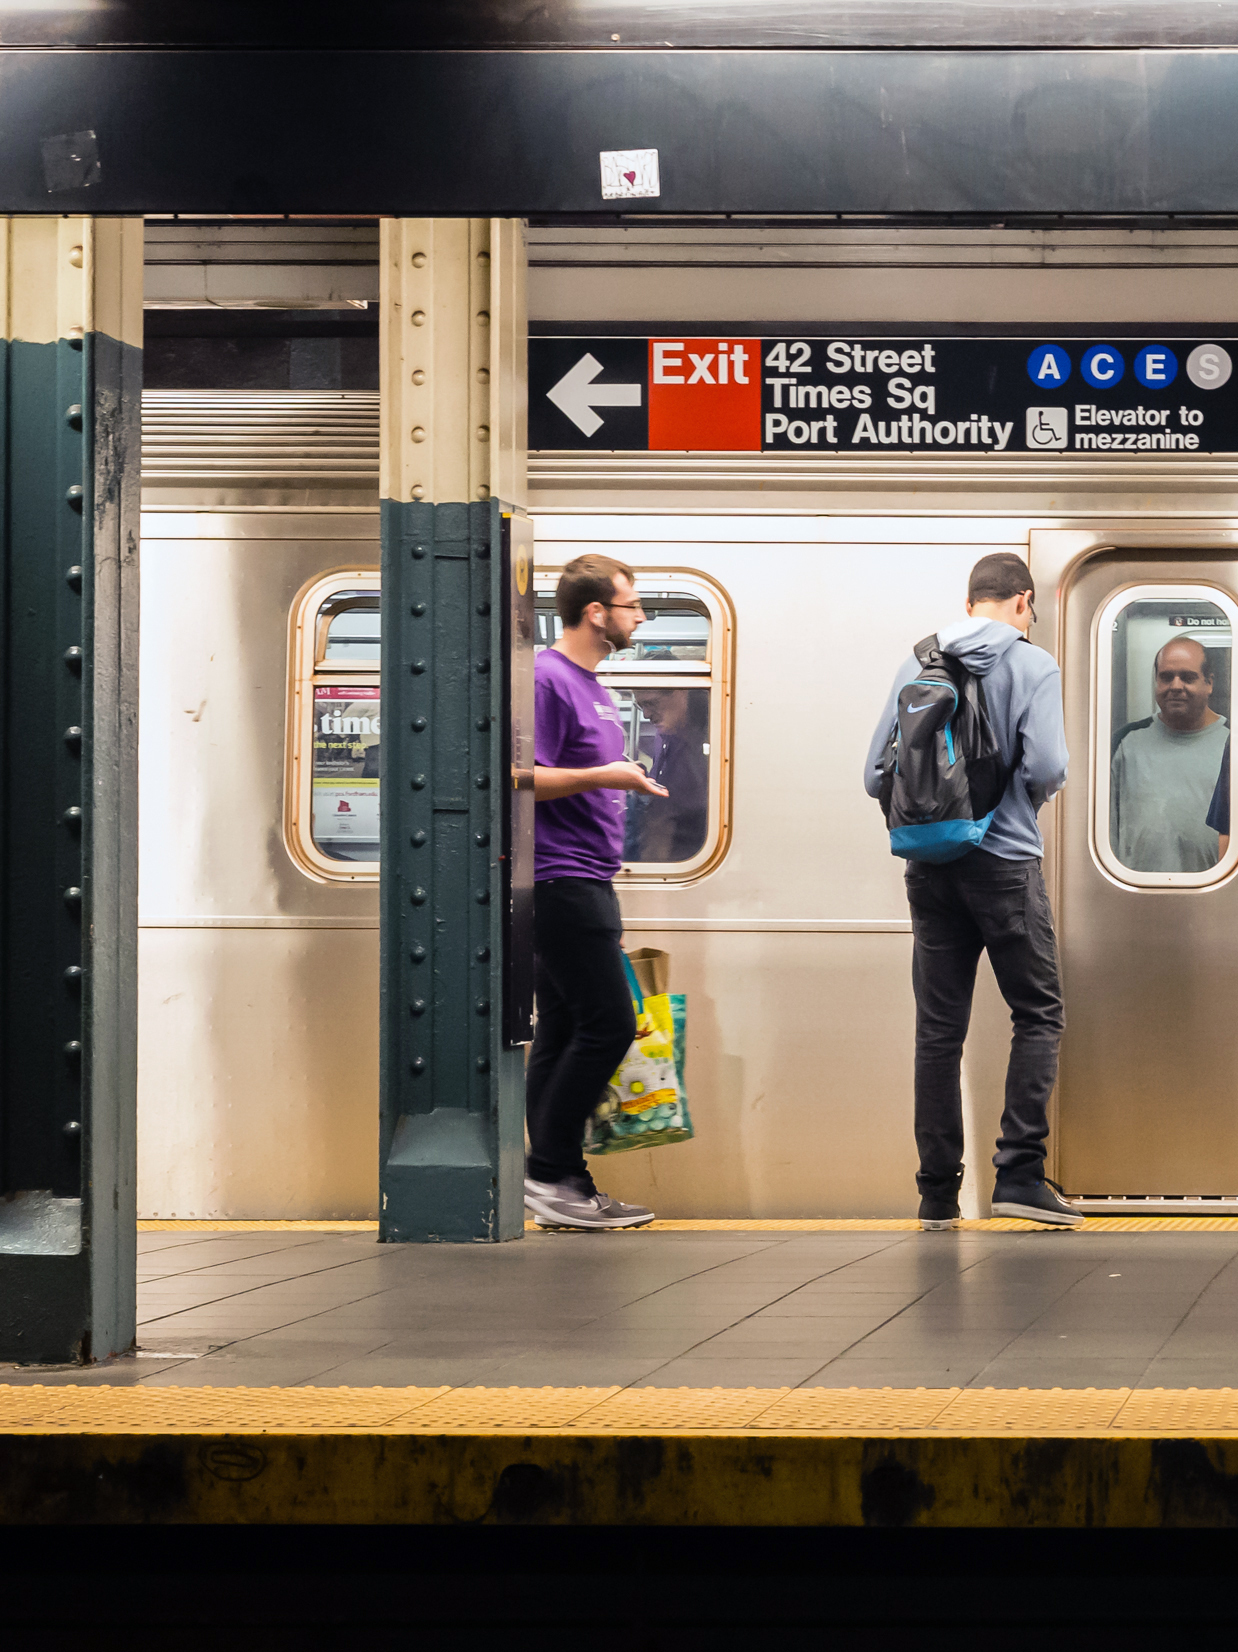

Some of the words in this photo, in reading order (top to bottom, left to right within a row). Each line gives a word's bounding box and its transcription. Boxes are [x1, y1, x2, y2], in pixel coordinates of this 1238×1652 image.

[652, 342, 749, 385] Exit
[765, 342, 812, 373] 42
[826, 342, 936, 374] Street
[1037, 353, 1061, 380] A
[1090, 353, 1115, 380] C
[1146, 354, 1166, 380] E
[1199, 354, 1221, 381] S
[766, 378, 873, 409] Times
[886, 377, 936, 415] Sq
[1074, 404, 1171, 426] Elevator
[1178, 405, 1204, 426] to
[765, 413, 838, 444] Port
[851, 413, 1014, 450] Authority
[1074, 428, 1200, 450] mezzanine
[1187, 618, 1200, 626] Do
[1201, 618, 1215, 626] not
[328, 741, 347, 749] next
